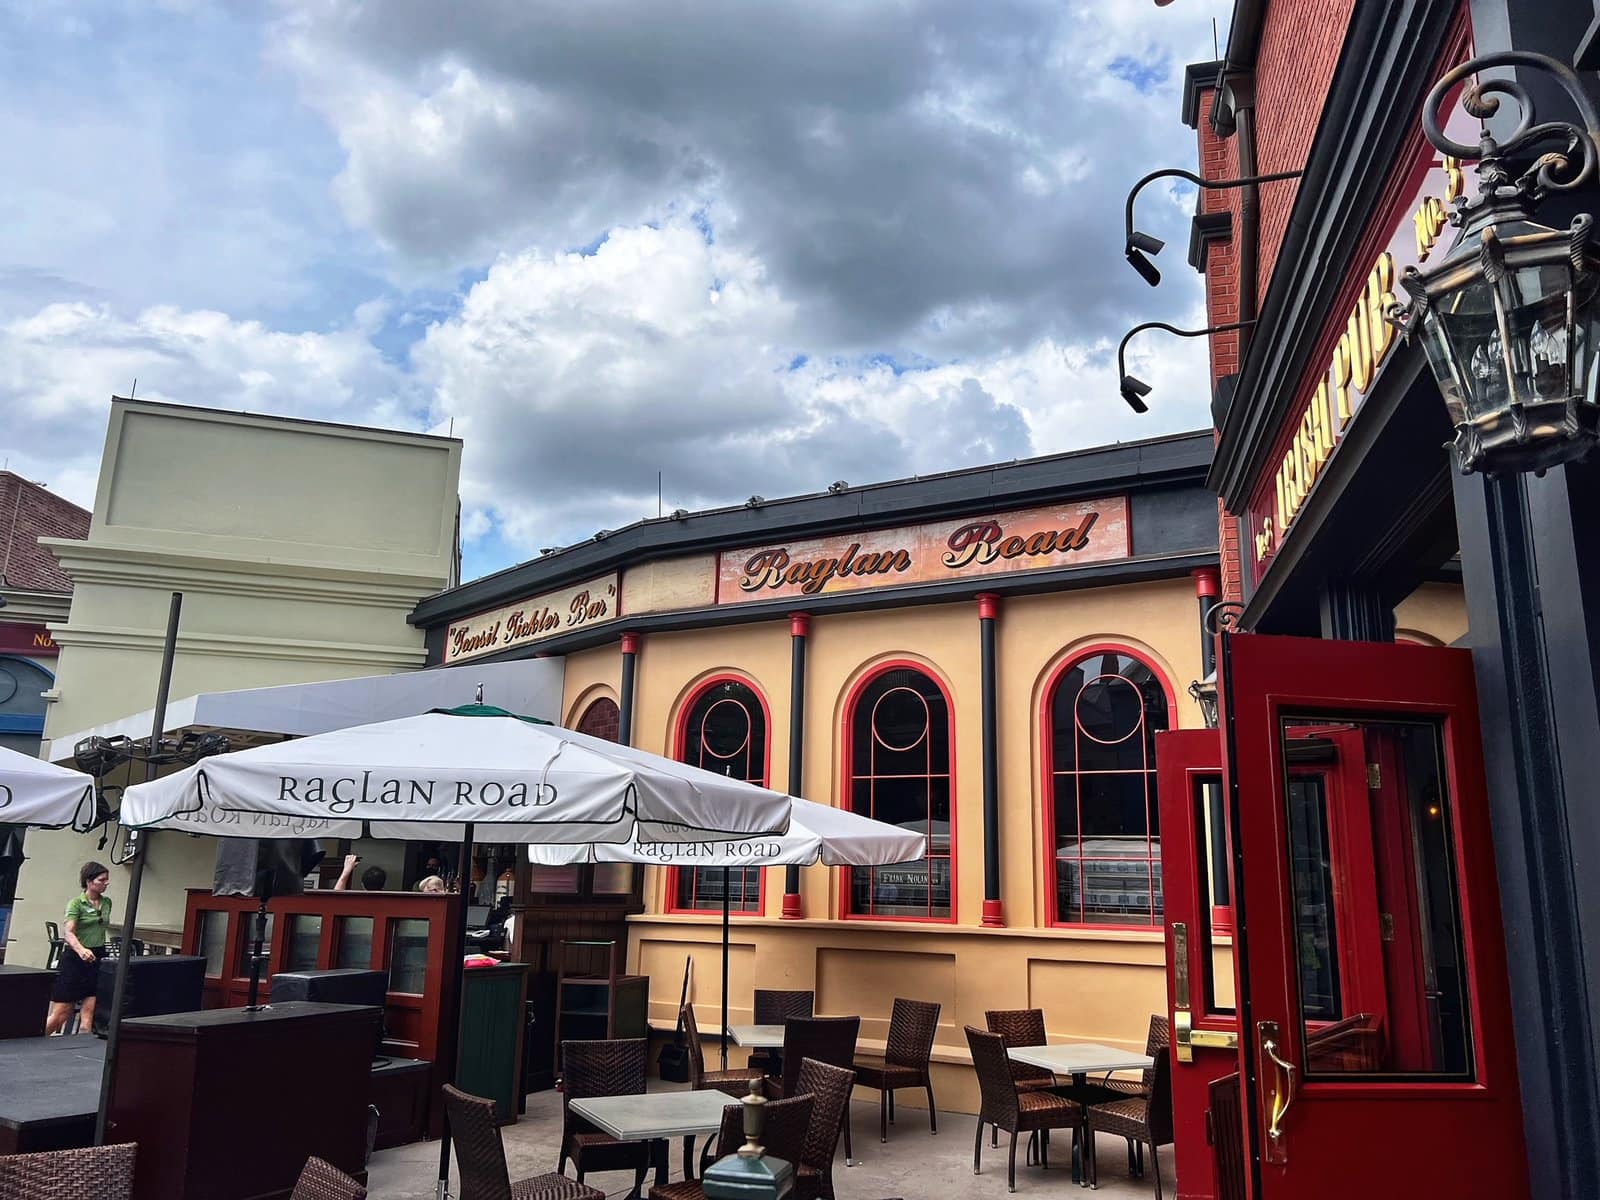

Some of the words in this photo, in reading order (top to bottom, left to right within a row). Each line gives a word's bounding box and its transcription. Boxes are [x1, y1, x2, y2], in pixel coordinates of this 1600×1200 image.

[1332, 252, 1398, 420] PUB
[738, 543, 912, 594] Raglan
[942, 512, 1100, 568] Road
[503, 607, 560, 643] Tickler
